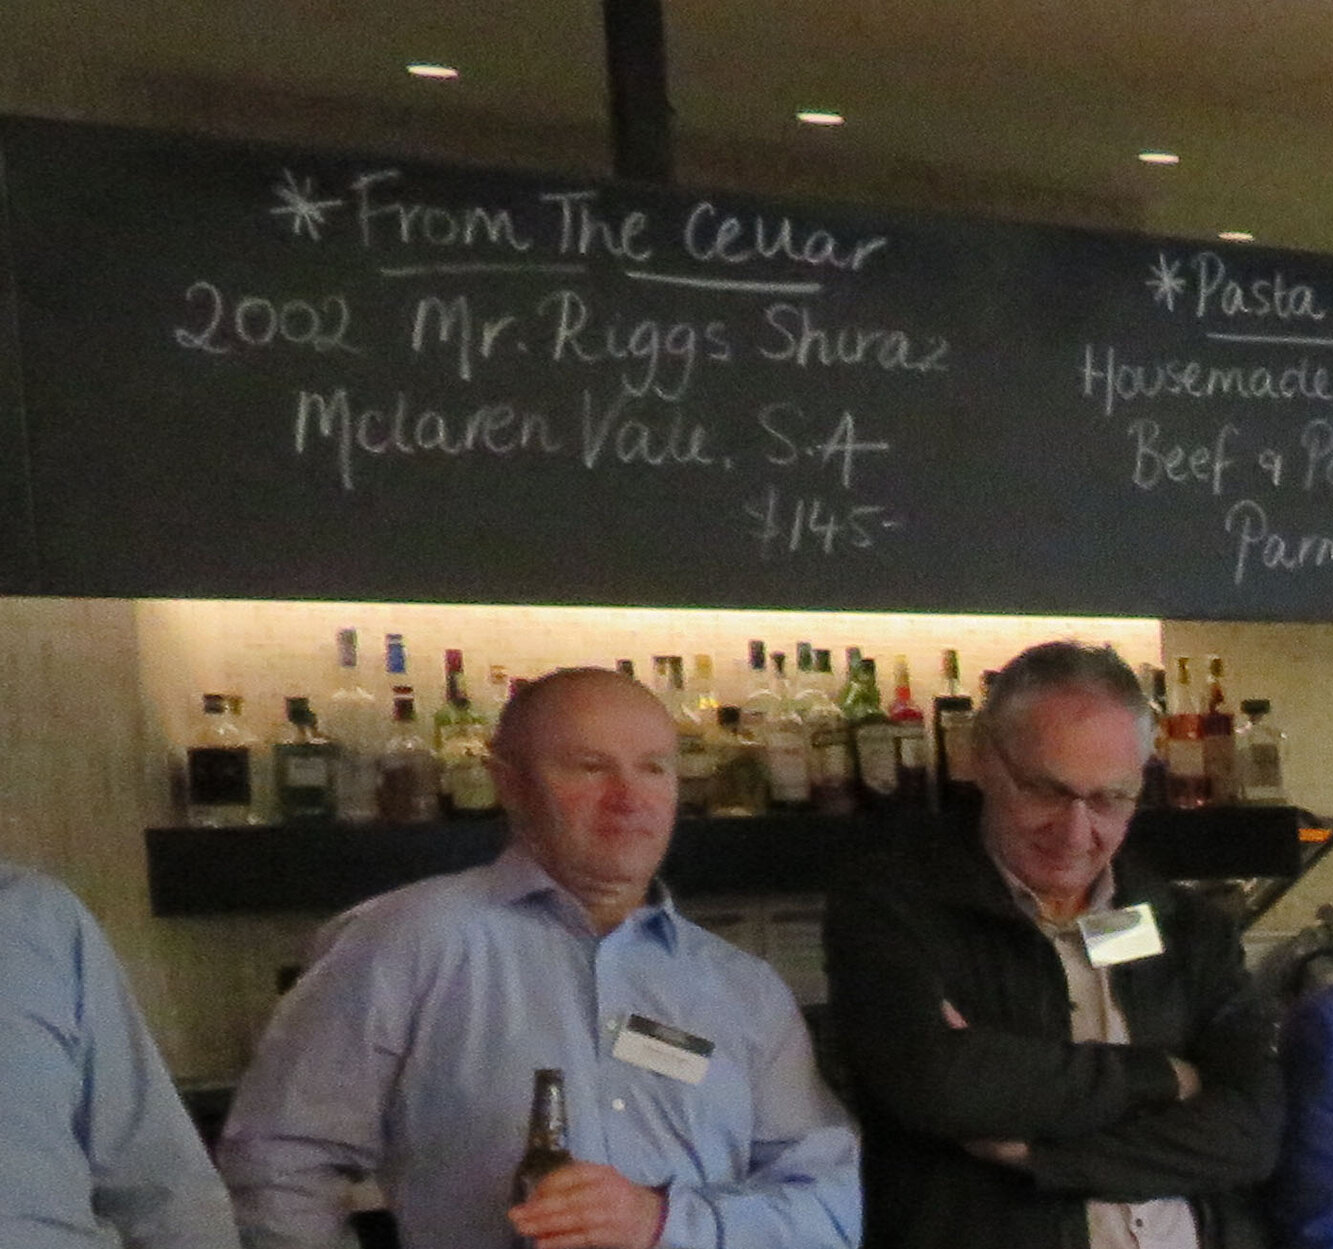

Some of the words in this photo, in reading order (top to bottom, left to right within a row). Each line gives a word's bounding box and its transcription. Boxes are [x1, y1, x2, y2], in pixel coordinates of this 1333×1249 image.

[351, 172, 531, 250] From
[540, 191, 650, 260] The
[684, 201, 890, 271] Cellar
[1197, 252, 1325, 318] Pasta
[173, 282, 362, 354] 2002
[411, 295, 528, 380] Mr.
[539, 291, 732, 400] Riggs
[759, 304, 952, 374] Shiraz
[1127, 418, 1240, 496] Beef
